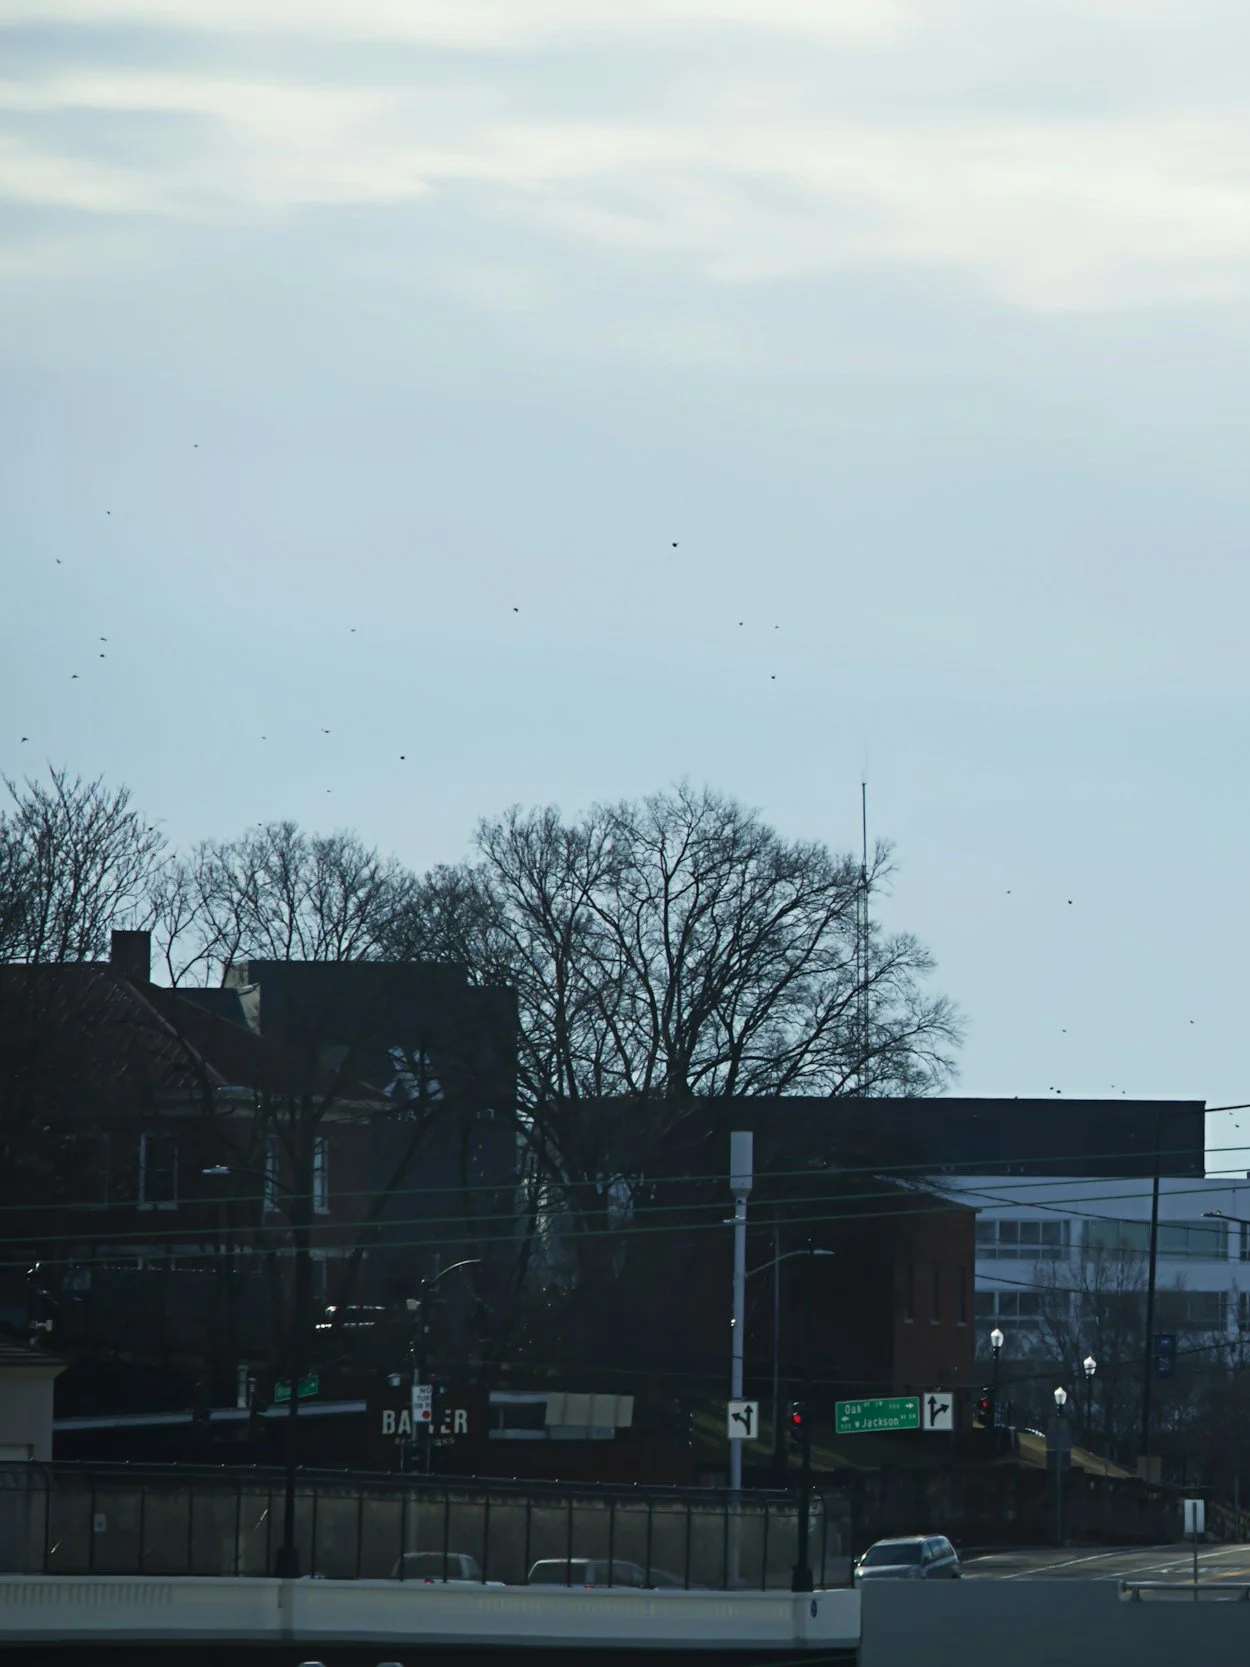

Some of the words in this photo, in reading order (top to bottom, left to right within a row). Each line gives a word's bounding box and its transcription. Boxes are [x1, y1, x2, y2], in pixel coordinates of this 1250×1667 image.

[844, 1404, 862, 1415] Oak
[382, 1409, 468, 1435] BAER
[862, 1418, 899, 1428] Jackson
